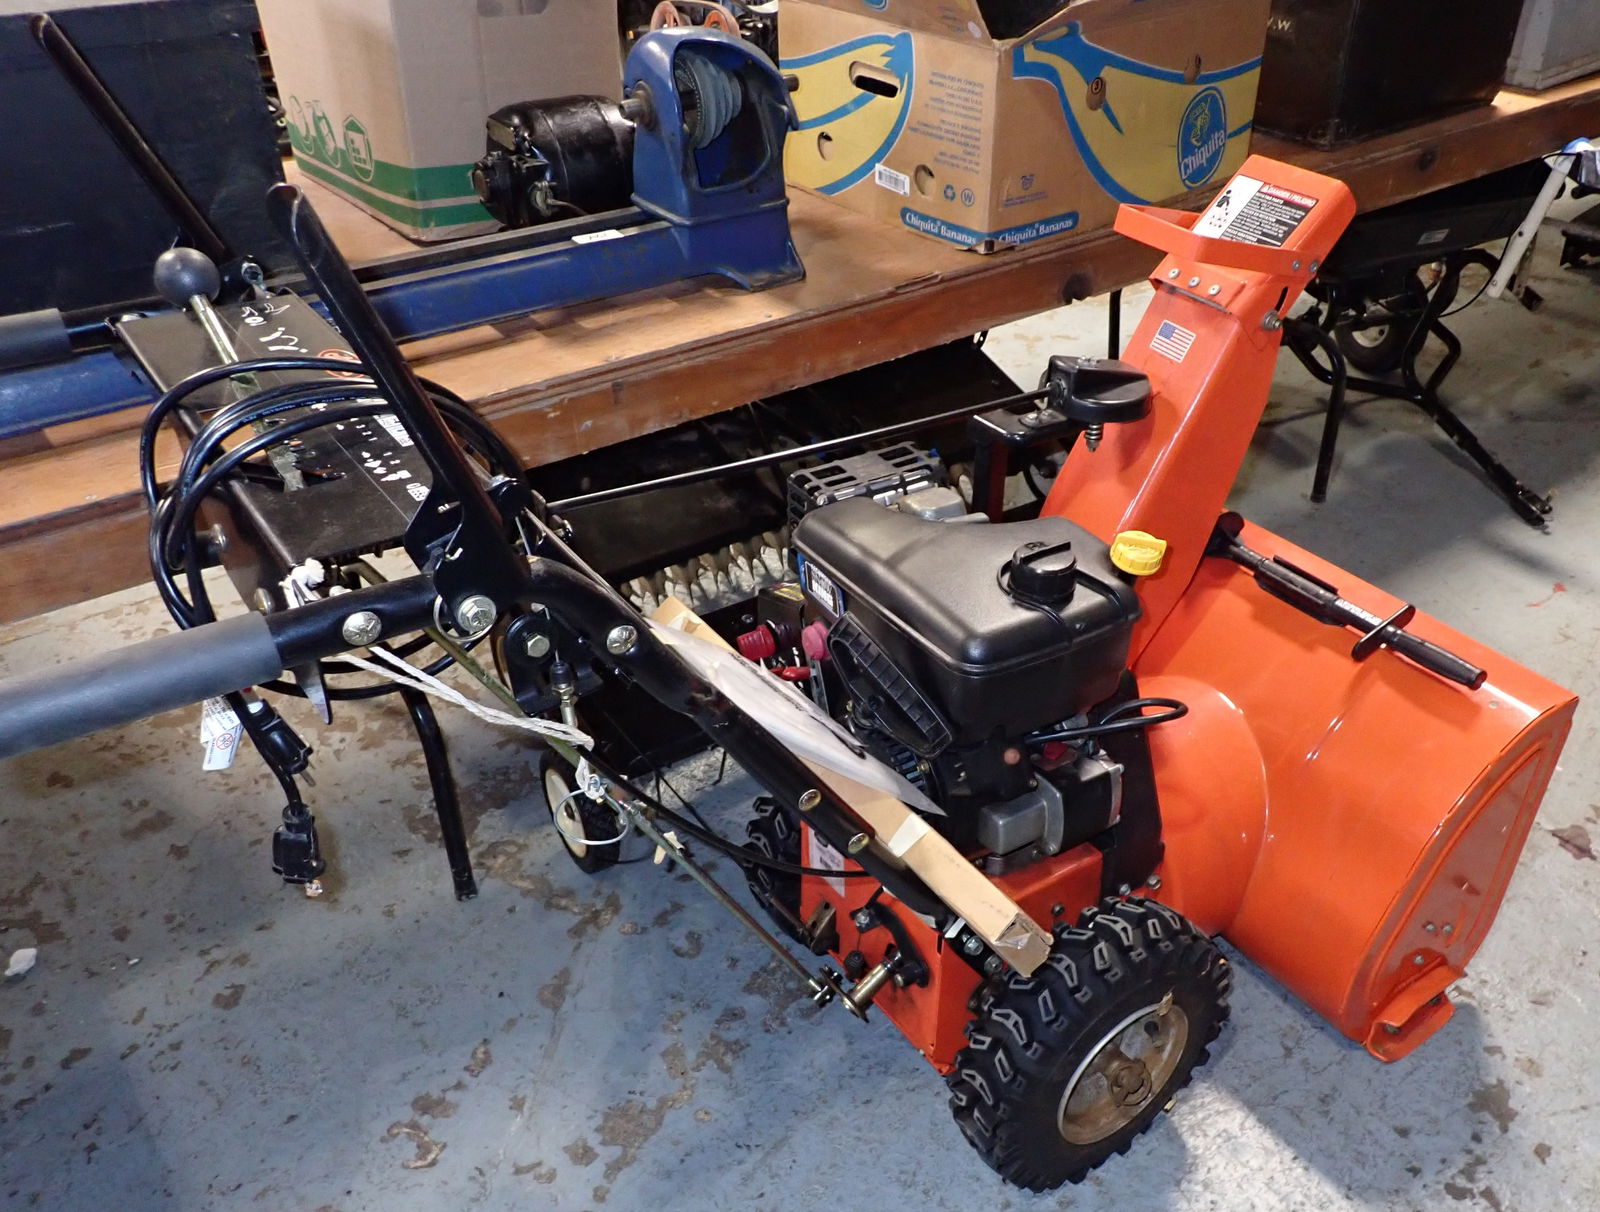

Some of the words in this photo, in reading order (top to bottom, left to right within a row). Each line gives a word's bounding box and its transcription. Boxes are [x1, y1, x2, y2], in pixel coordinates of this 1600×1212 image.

[1180, 129, 1225, 180] Chiquita
[962, 190, 974, 205] W
[906, 212, 939, 232] Chiquita
[940, 225, 977, 245] Bananas
[998, 228, 1037, 244] Chiquita
[1039, 219, 1073, 234] Bananas
